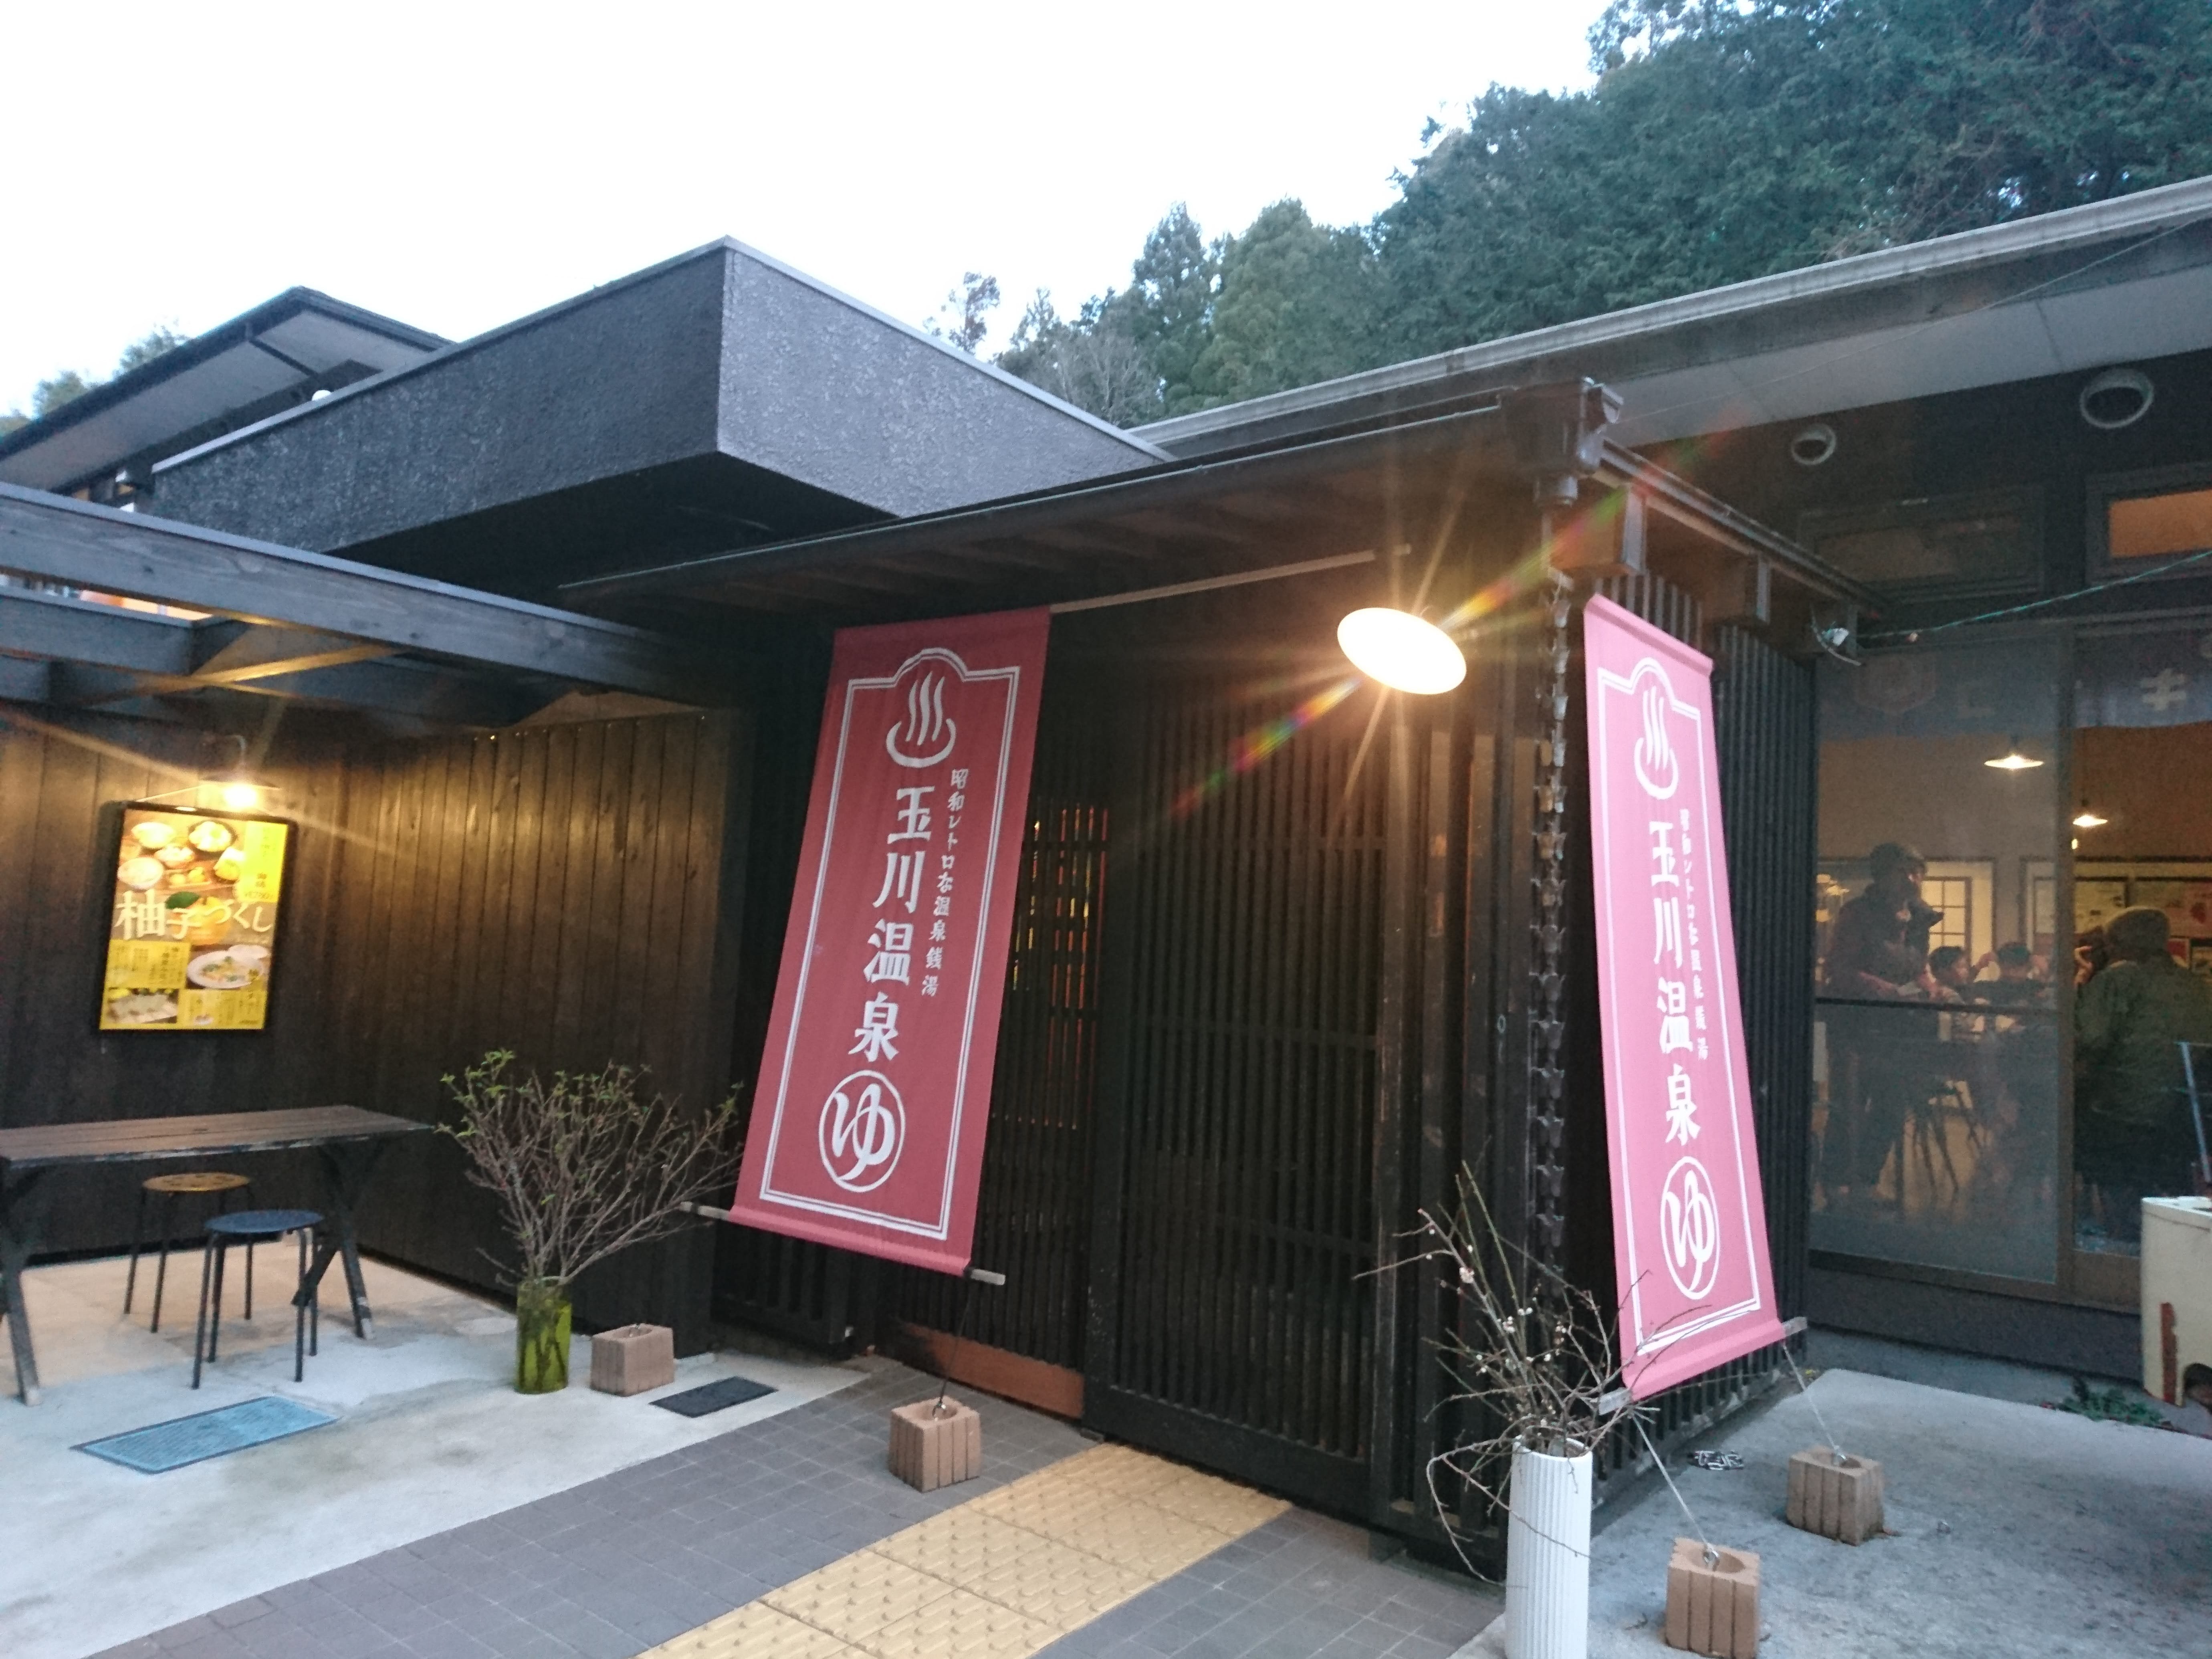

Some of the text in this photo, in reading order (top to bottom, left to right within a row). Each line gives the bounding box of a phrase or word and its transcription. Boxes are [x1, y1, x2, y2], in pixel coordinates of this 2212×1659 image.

[114, 888, 273, 940] 柚子づくし
[847, 786, 935, 1063] 玉川温泉
[921, 769, 969, 997] 昭和レトロな温泉銭湯
[1648, 820, 1701, 1146] 玉川温泉
[832, 1083, 896, 1181] ゆ
[1664, 1169, 1715, 1292] ゆ
